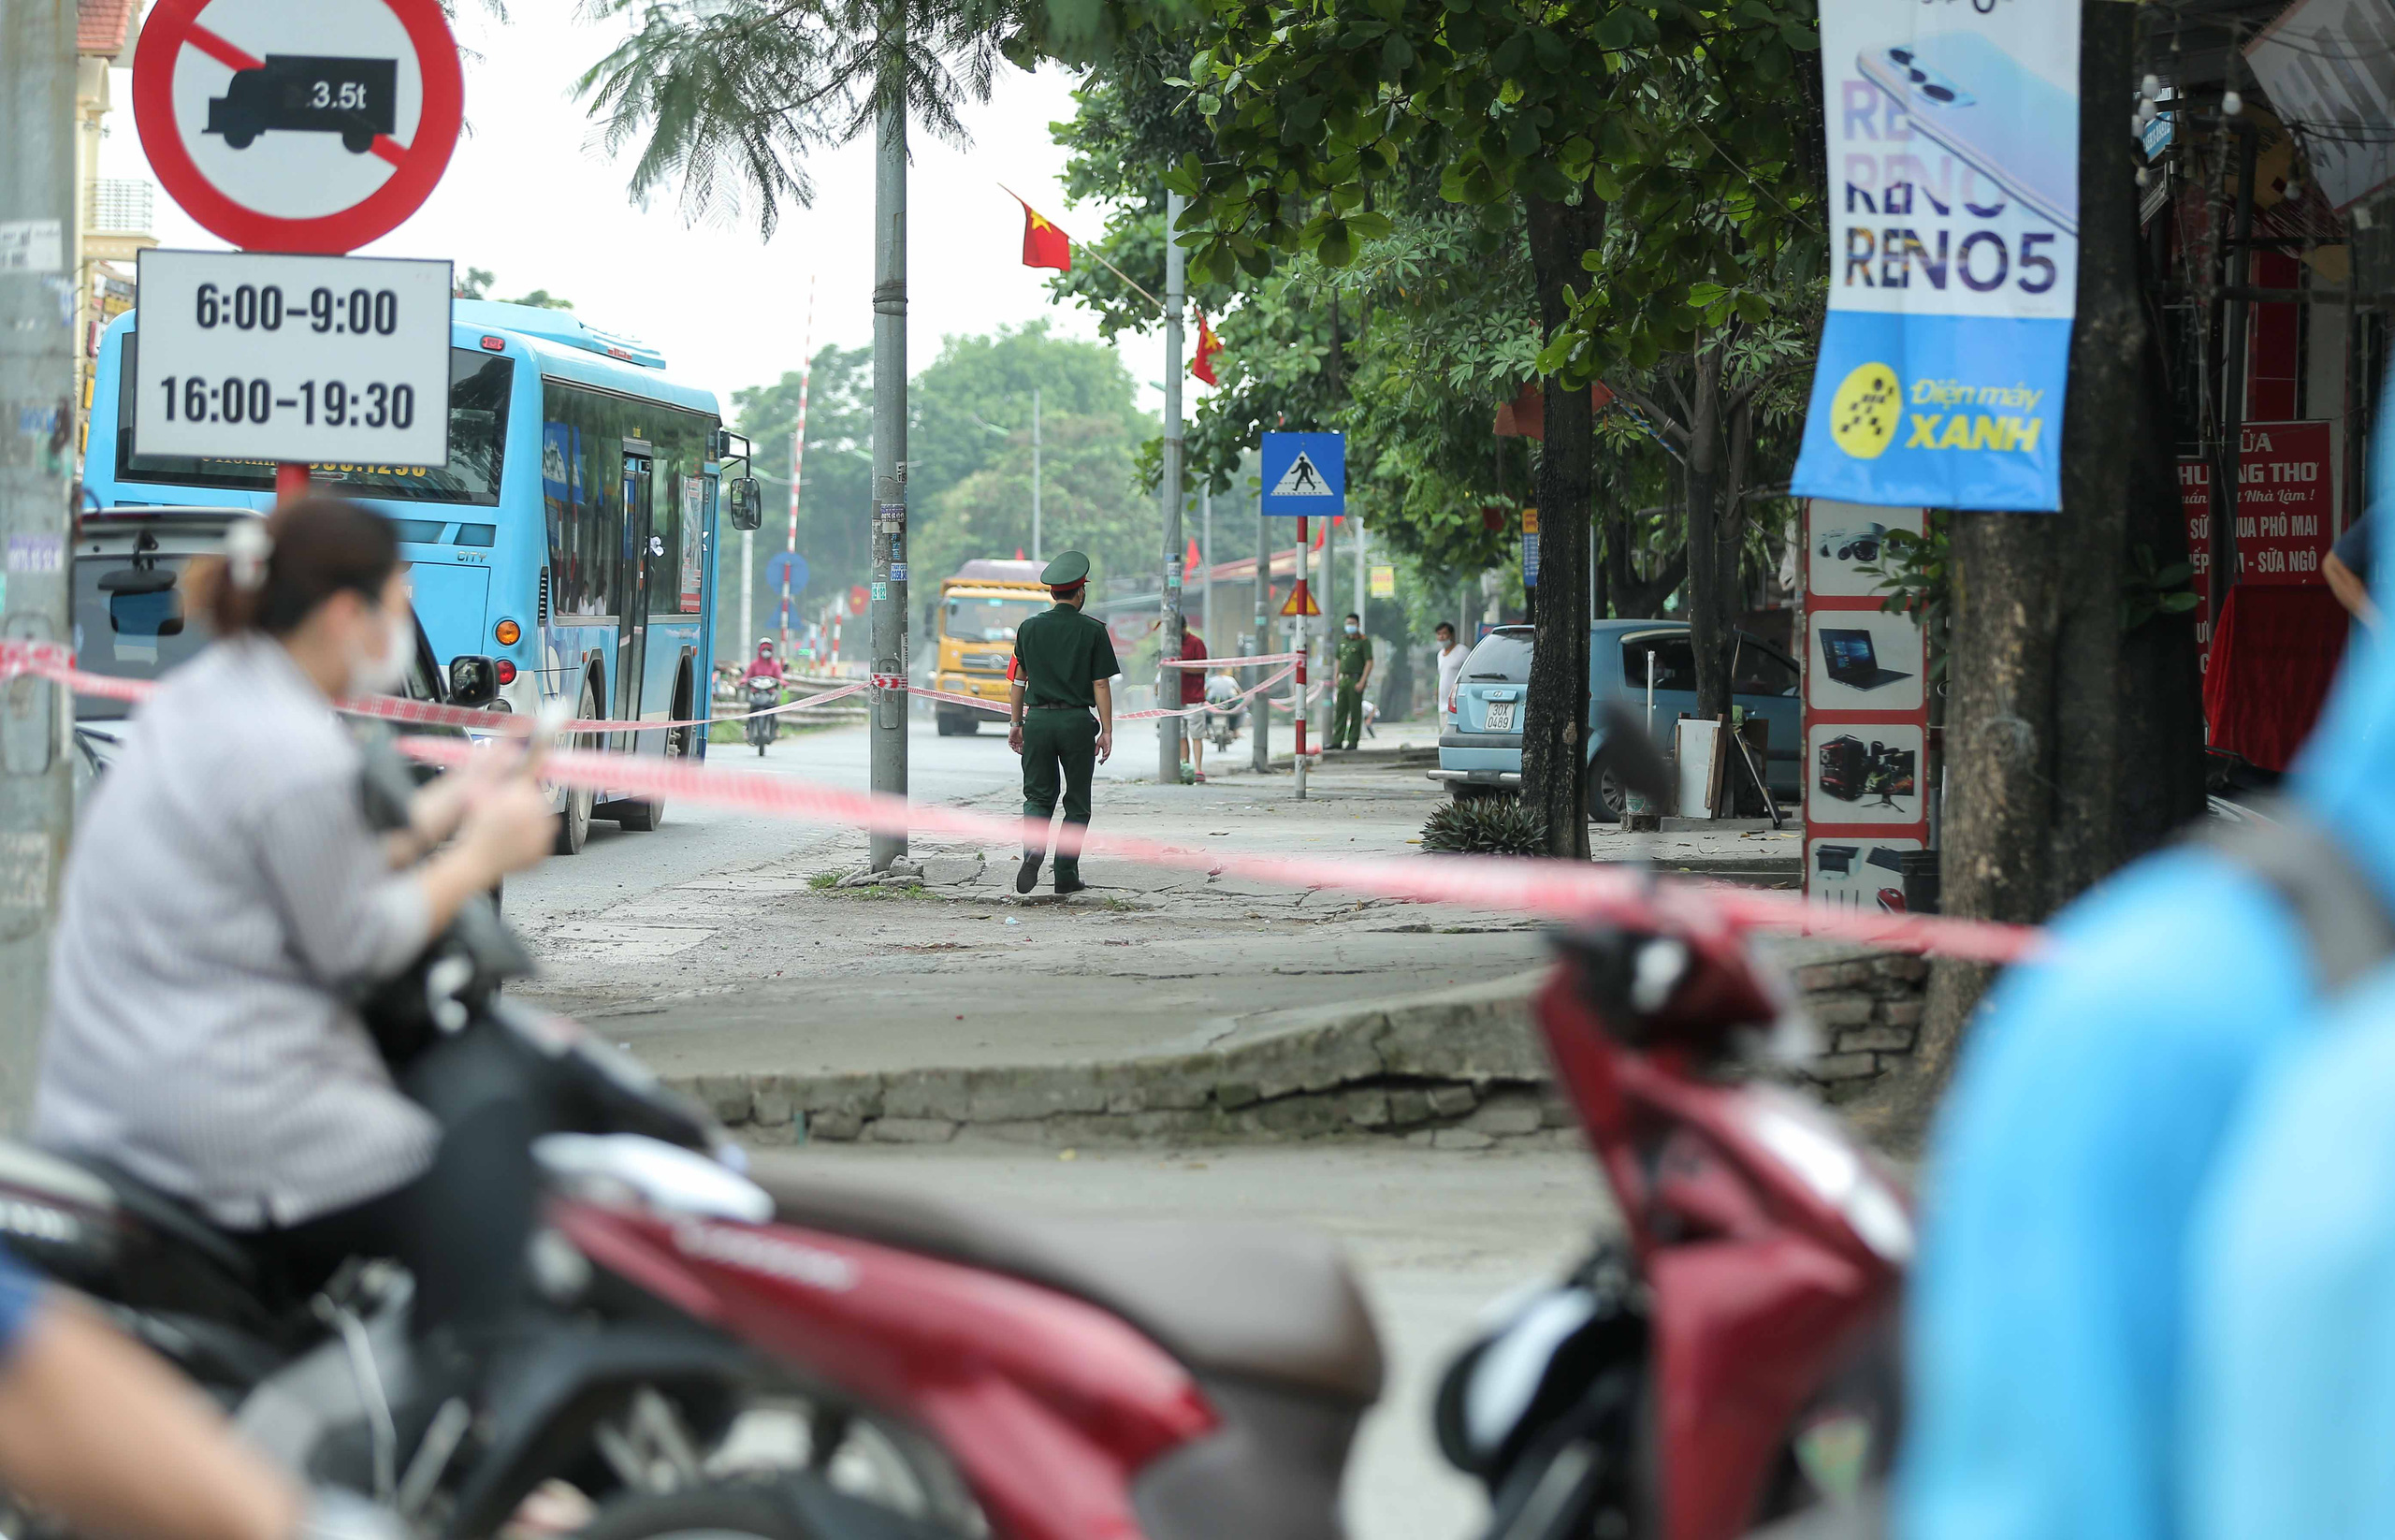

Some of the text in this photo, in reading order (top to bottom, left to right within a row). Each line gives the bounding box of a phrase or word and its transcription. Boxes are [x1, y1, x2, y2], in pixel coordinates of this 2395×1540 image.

[312, 80, 367, 109] 3.5t
[1844, 227, 2056, 294] RENO5
[196, 283, 398, 335] 6:00-9:00
[161, 376, 414, 429] 16:00-19:30
[1909, 378, 2044, 413] Điện máy
[1905, 414, 2043, 452] XANH
[2239, 429, 2273, 453] ỮA
[2269, 461, 2319, 483] THƠ
[2182, 488, 2208, 504] uấn
[2245, 489, 2274, 502] Nhà
[2277, 488, 2306, 504] Làm
[2190, 514, 2210, 540] SỮ
[2260, 512, 2287, 538] PHÔ
[2291, 515, 2318, 536] MAI
[457, 551, 486, 563] CITY
[2188, 546, 2210, 574] ẾP
[2257, 547, 2286, 573] SỮA
[2288, 545, 2317, 572] NGÔ
[1488, 716, 1509, 729] 0489
